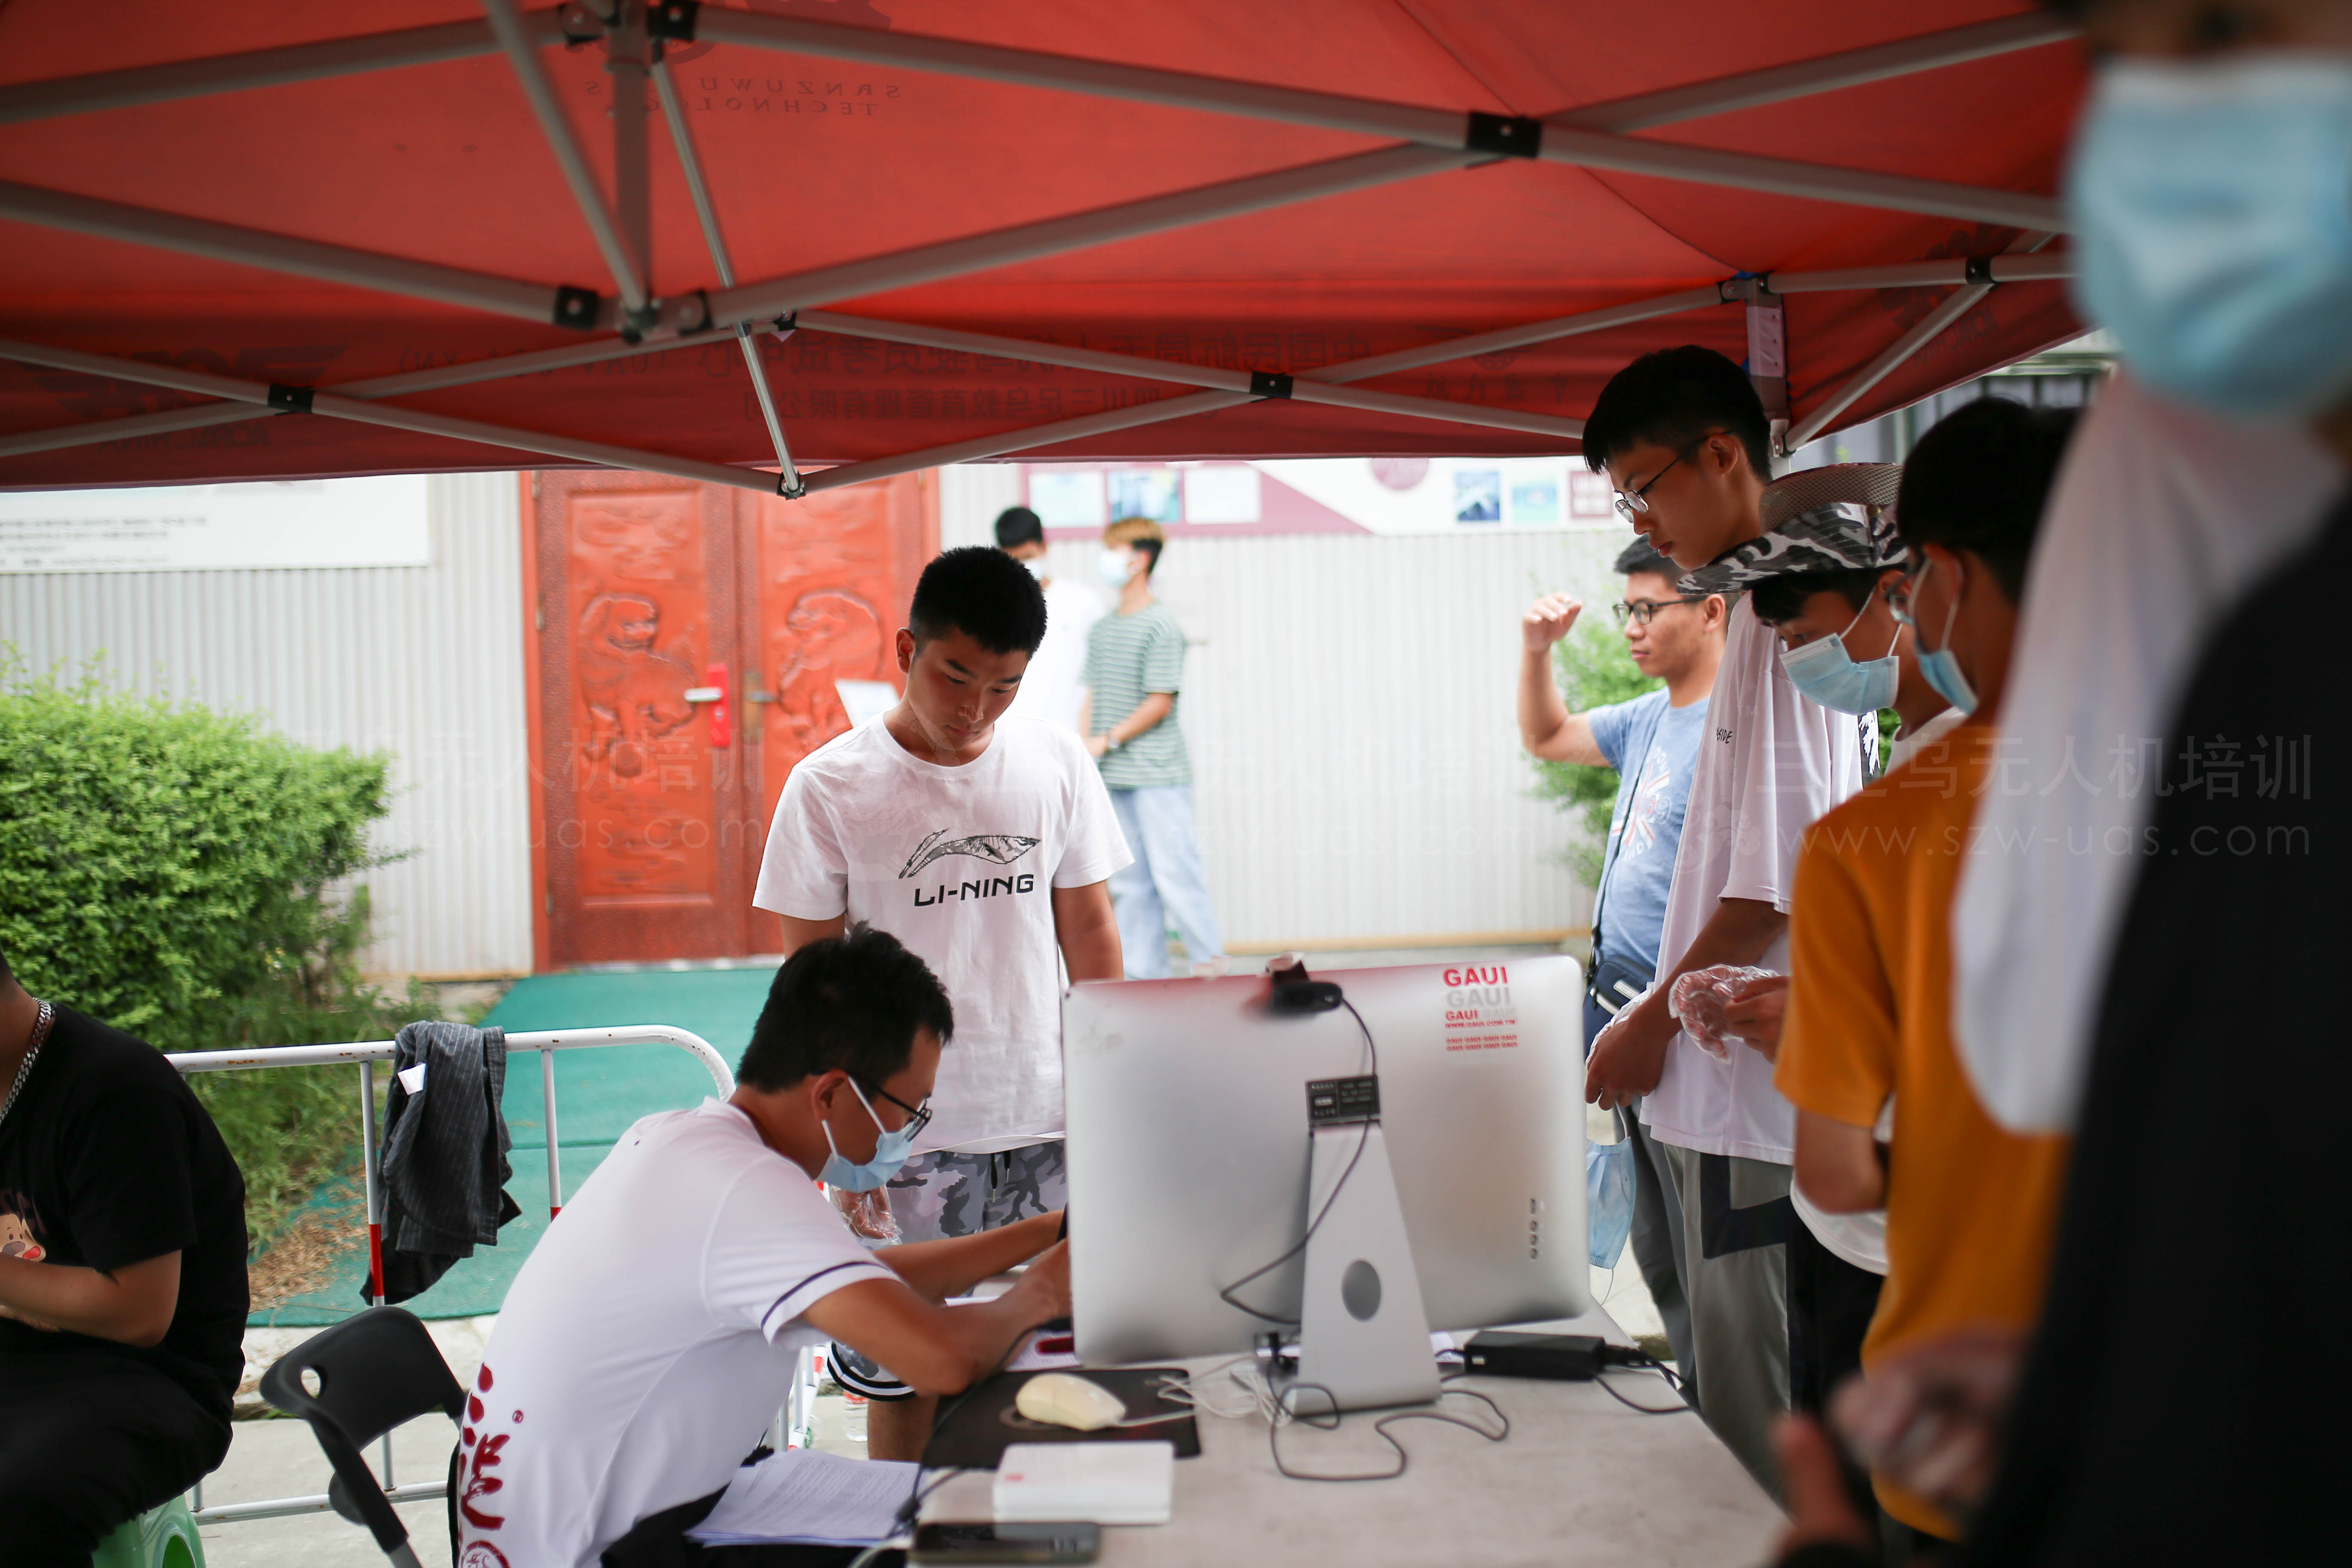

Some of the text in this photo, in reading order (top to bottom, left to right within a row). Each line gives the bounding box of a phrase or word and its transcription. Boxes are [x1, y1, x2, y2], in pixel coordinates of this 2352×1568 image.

[914, 874, 1034, 907] LI-NING
[1443, 966, 1508, 987] GAUI
[1446, 987, 1511, 1008] GAUI
[1445, 1008, 1479, 1021] GAUI
